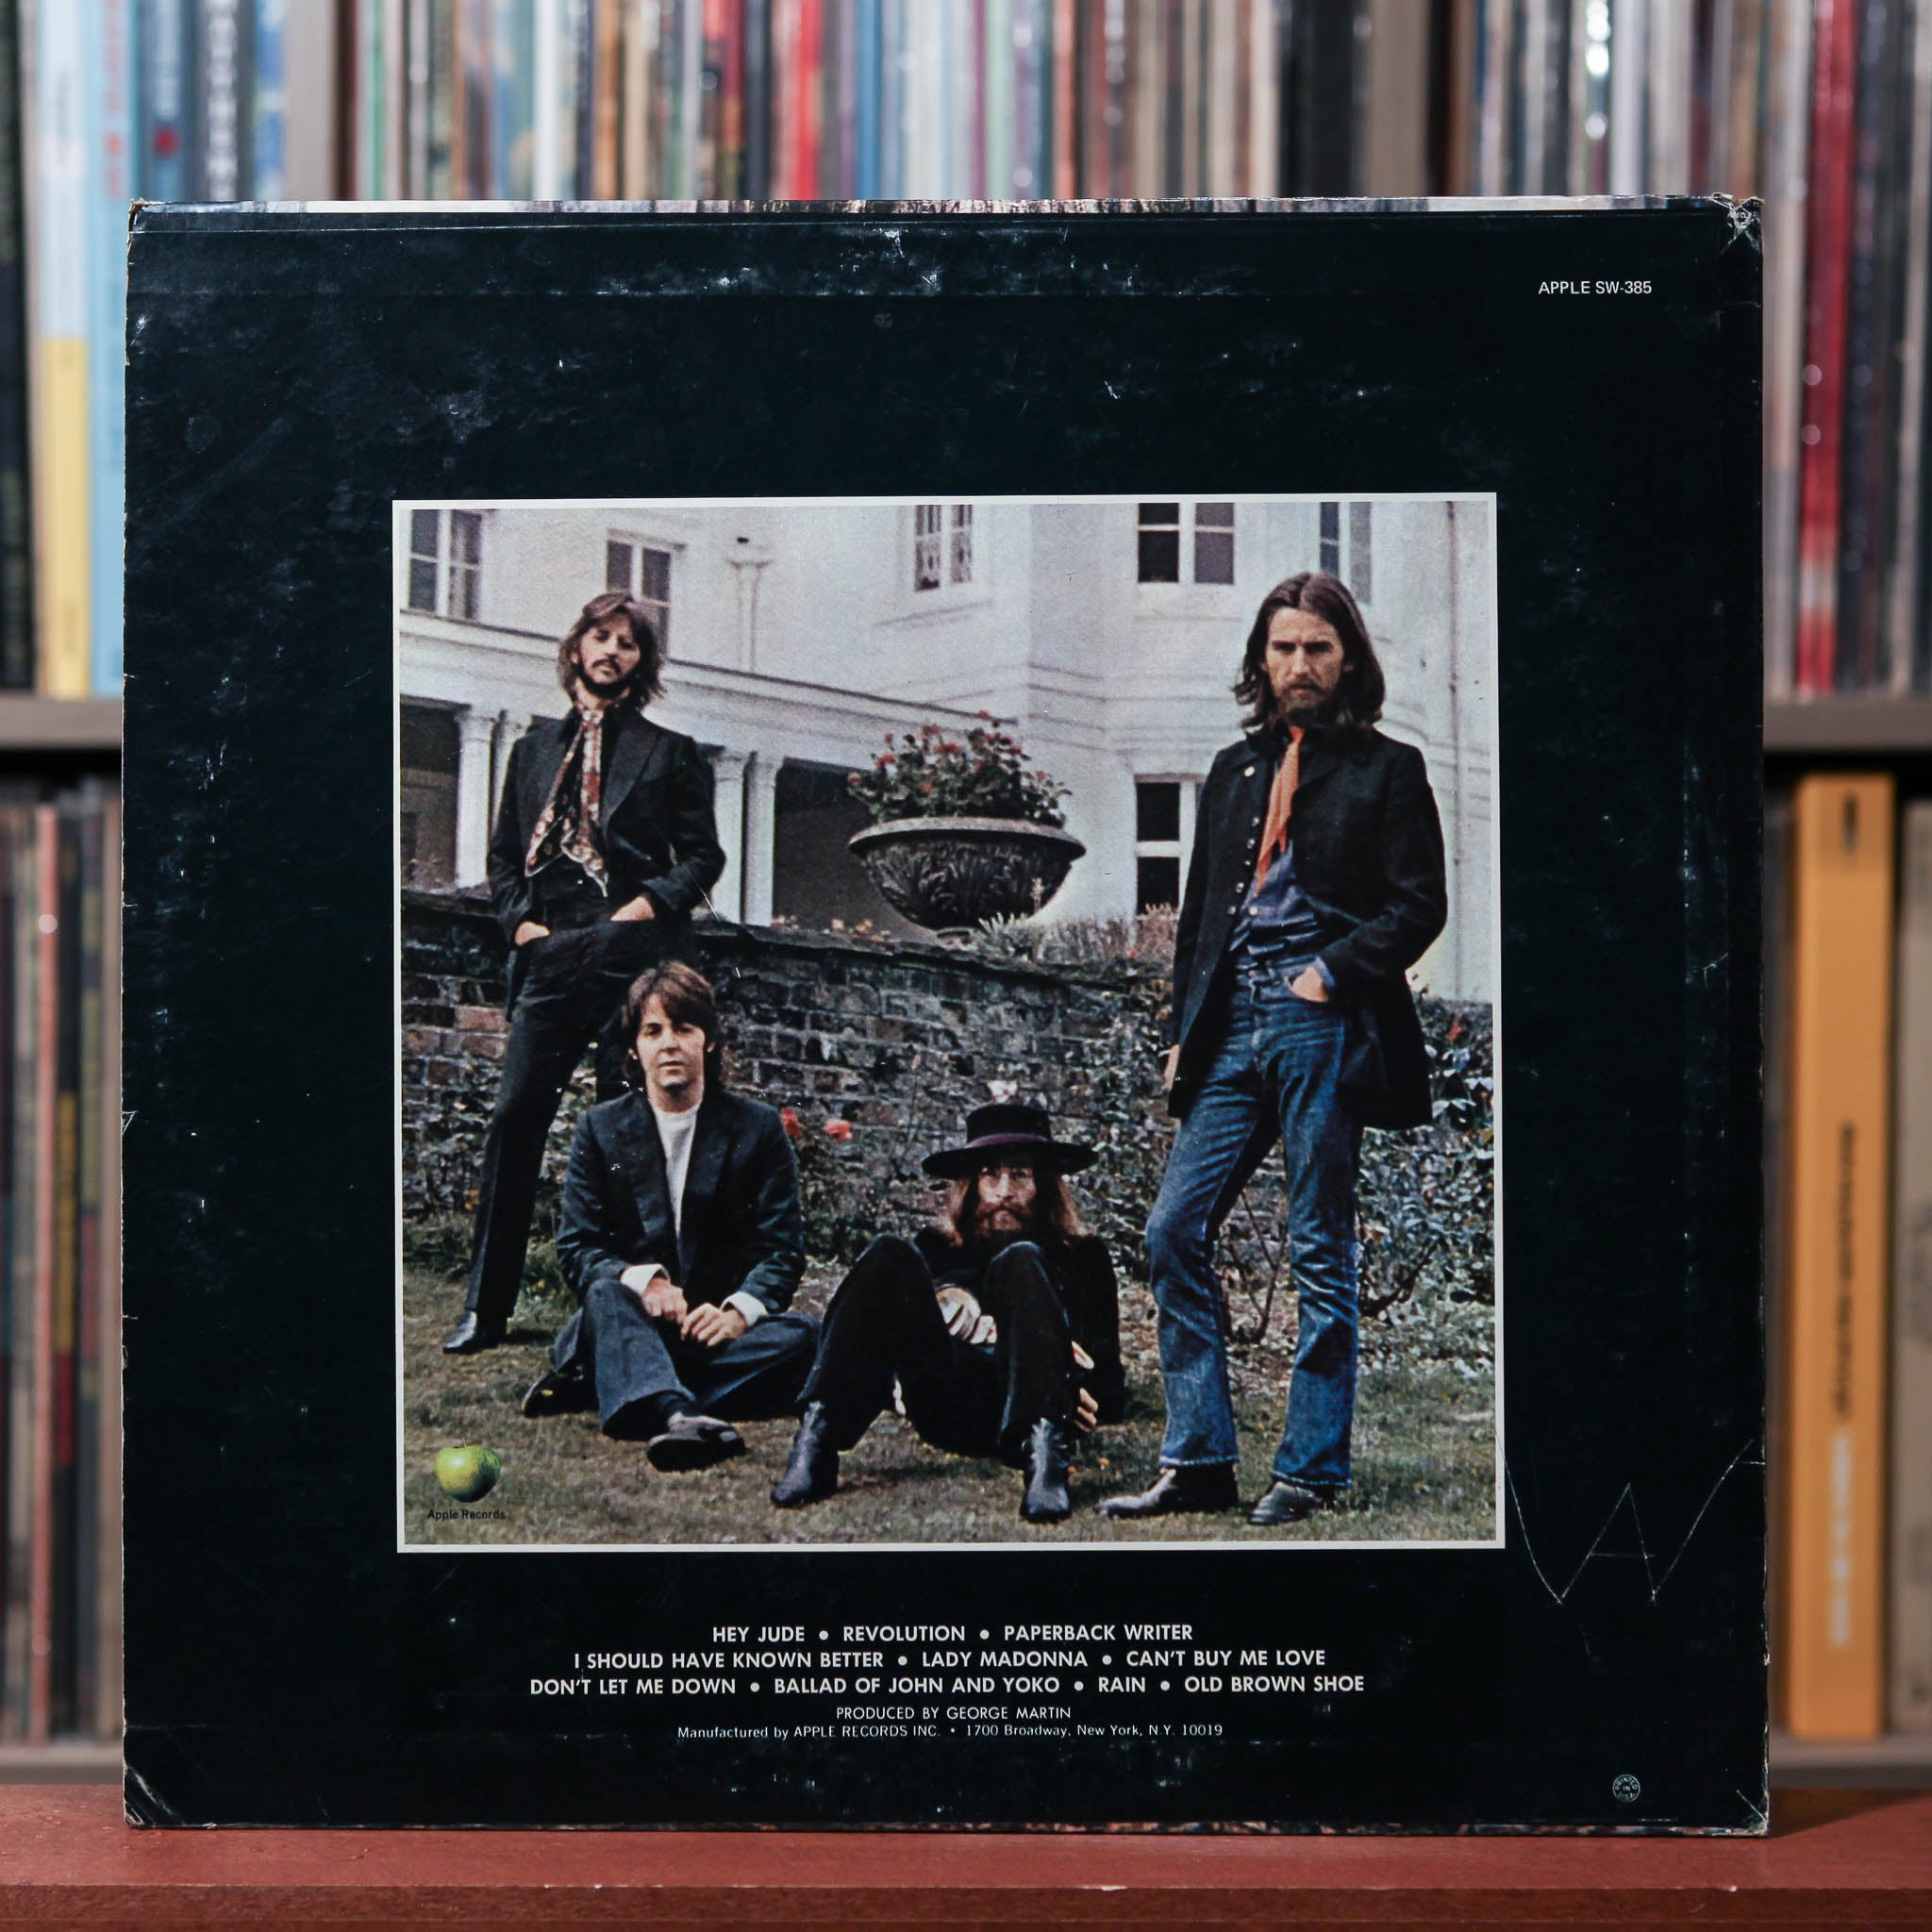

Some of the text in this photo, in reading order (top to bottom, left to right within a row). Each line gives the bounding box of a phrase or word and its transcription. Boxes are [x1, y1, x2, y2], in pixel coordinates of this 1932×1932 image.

[1538, 280, 1653, 295] APPLE SW-385
[426, 1508, 507, 1523] Apple Records
[712, 1624, 1193, 1642] HEY JUDE REVOLUTION PAPERBACK WRITER
[575, 1649, 1325, 1670] I SHOULD HAVE KNOWN BETTER LADY MADONNA CAN'T BUY ME LOVE
[530, 1675, 1364, 1695] DON'T LET ME DOWN BALLAD OF JOHN AND YOKO RAIN OLD BROWN SHOE
[836, 1706, 1071, 1720] PRODUCED BY GEORGE MARTIN
[677, 1725, 769, 1739] Manufactured
[774, 1725, 789, 1741] by
[793, 1725, 837, 1738] APPLE
[841, 1724, 908, 1738] RECORDS
[913, 1724, 941, 1738] INC.
[966, 1724, 999, 1737] 1700
[1004, 1724, 1072, 1740] Broadway,
[1077, 1724, 1105, 1737] New
[1109, 1724, 1143, 1738] York,
[1182, 1724, 1224, 1737] 10019
